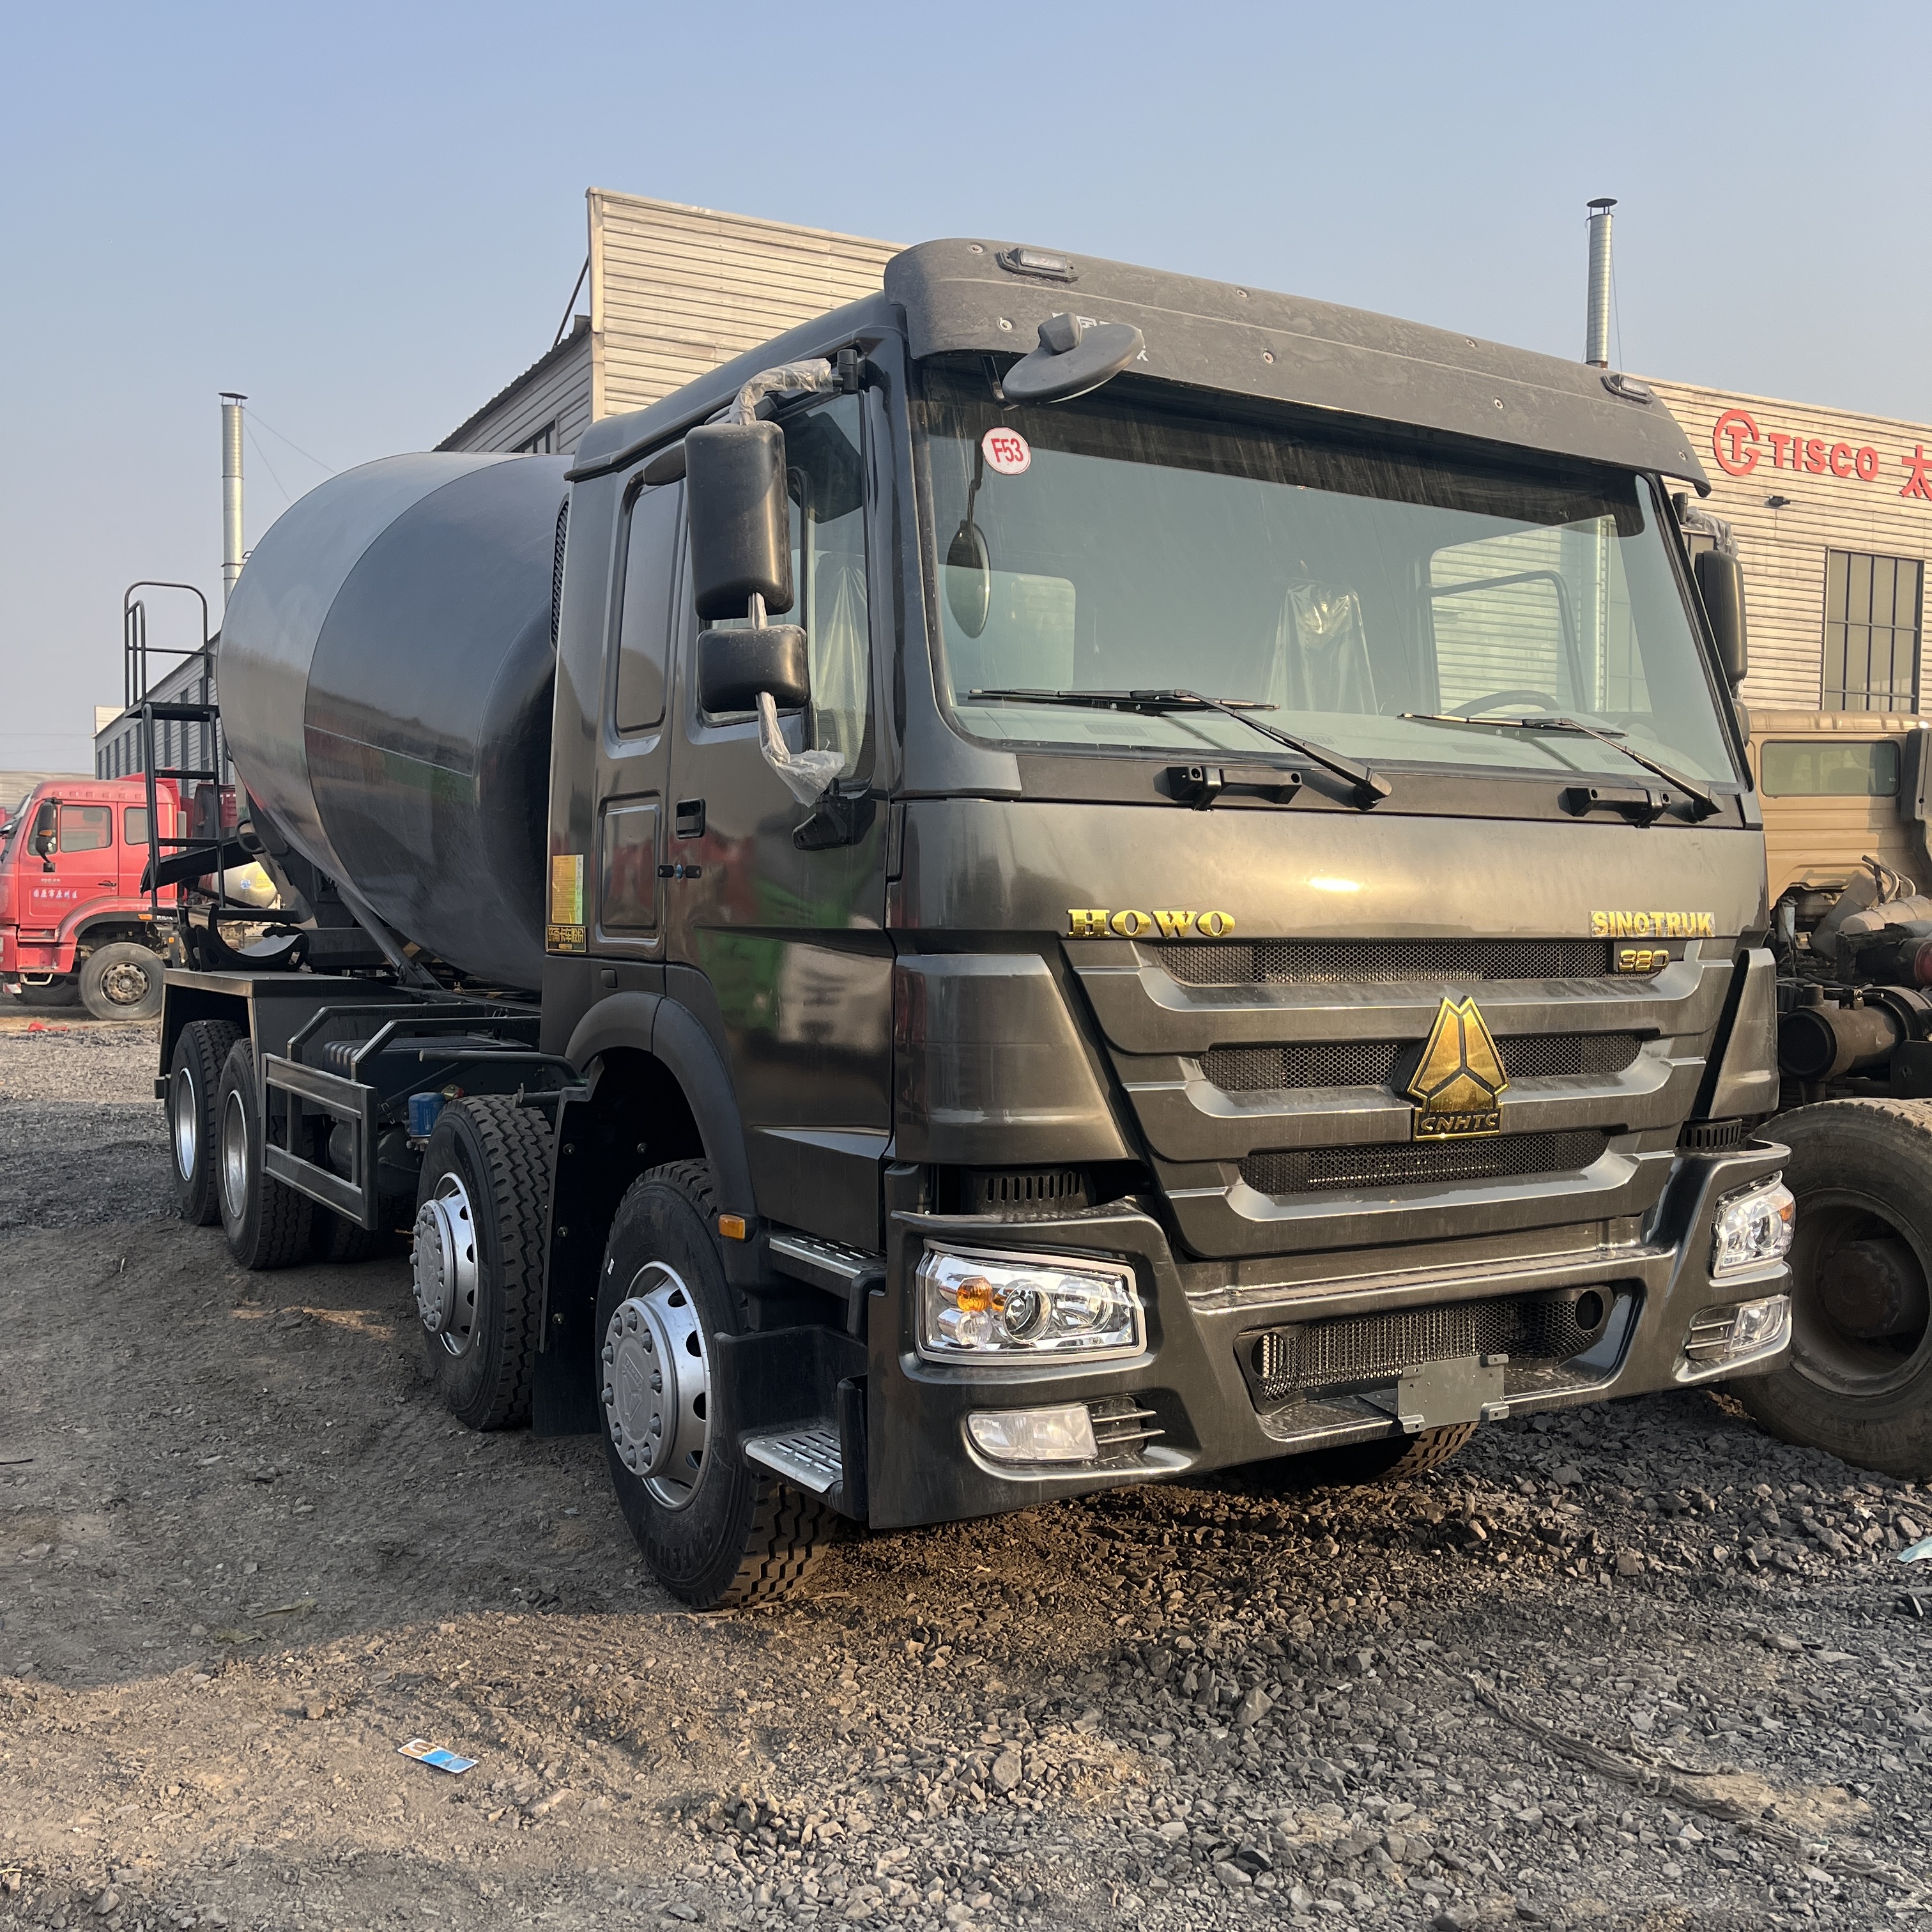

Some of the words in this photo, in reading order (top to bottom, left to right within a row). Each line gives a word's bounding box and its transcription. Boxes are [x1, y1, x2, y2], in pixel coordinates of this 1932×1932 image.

[991, 438, 1024, 463] F53
[1768, 433, 1880, 481] TISCO
[1899, 444, 1932, 501] 太
[1068, 908, 1236, 938] HOWO
[1592, 911, 1713, 937] SINOTRUK
[1618, 949, 1669, 972] 380
[1420, 1113, 1499, 1132] CNHTC
